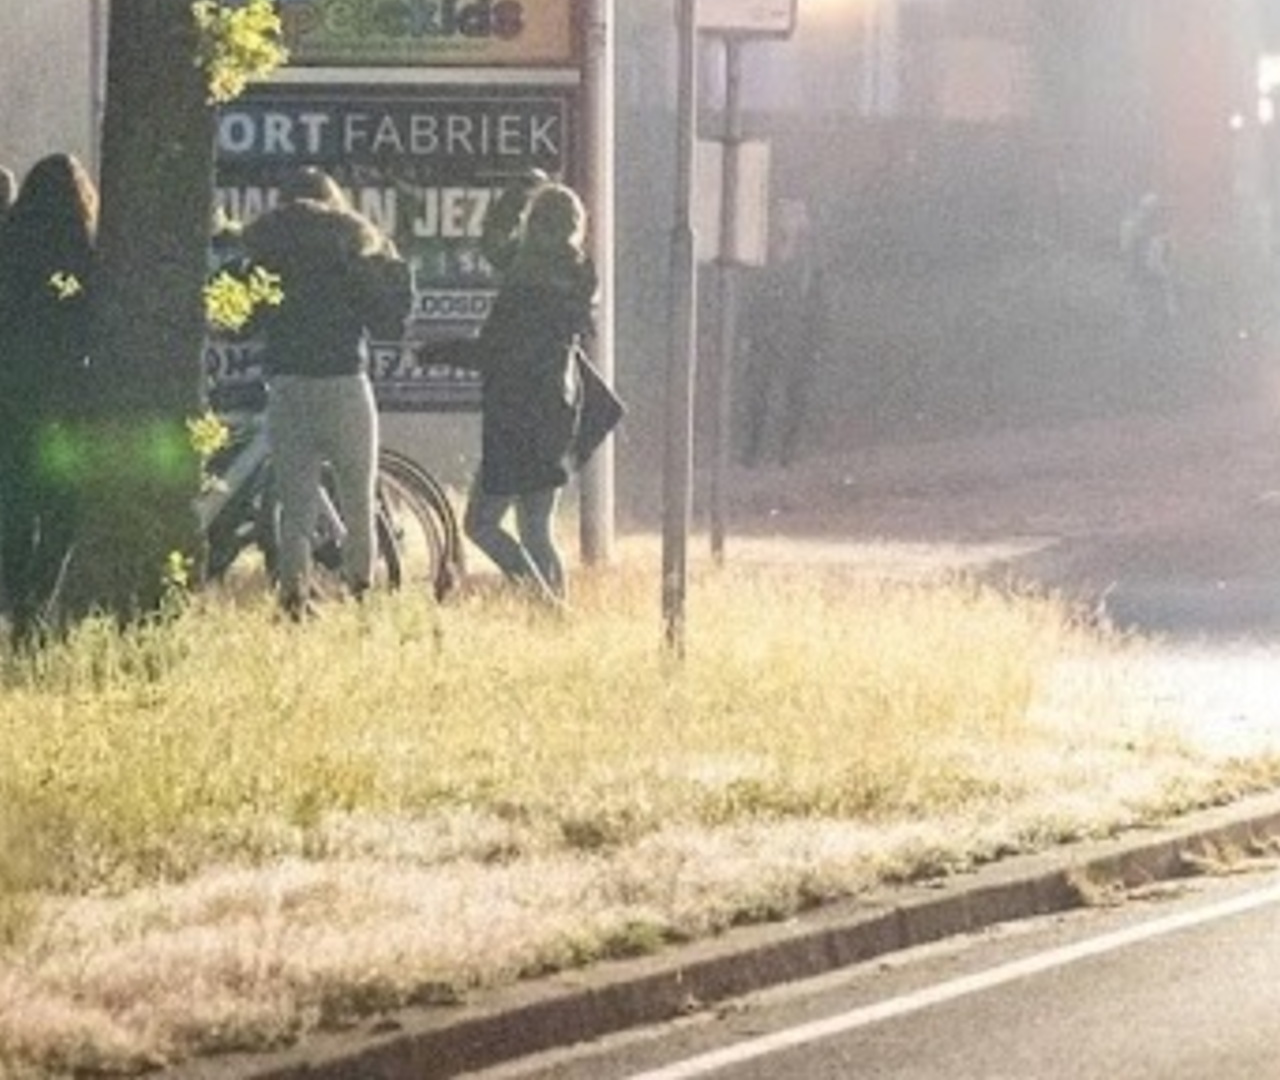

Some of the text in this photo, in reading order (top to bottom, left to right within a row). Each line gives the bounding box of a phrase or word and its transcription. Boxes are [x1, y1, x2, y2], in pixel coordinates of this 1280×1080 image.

[219, 111, 560, 156] ORT FABRIEK
[413, 187, 502, 238] JEZ
